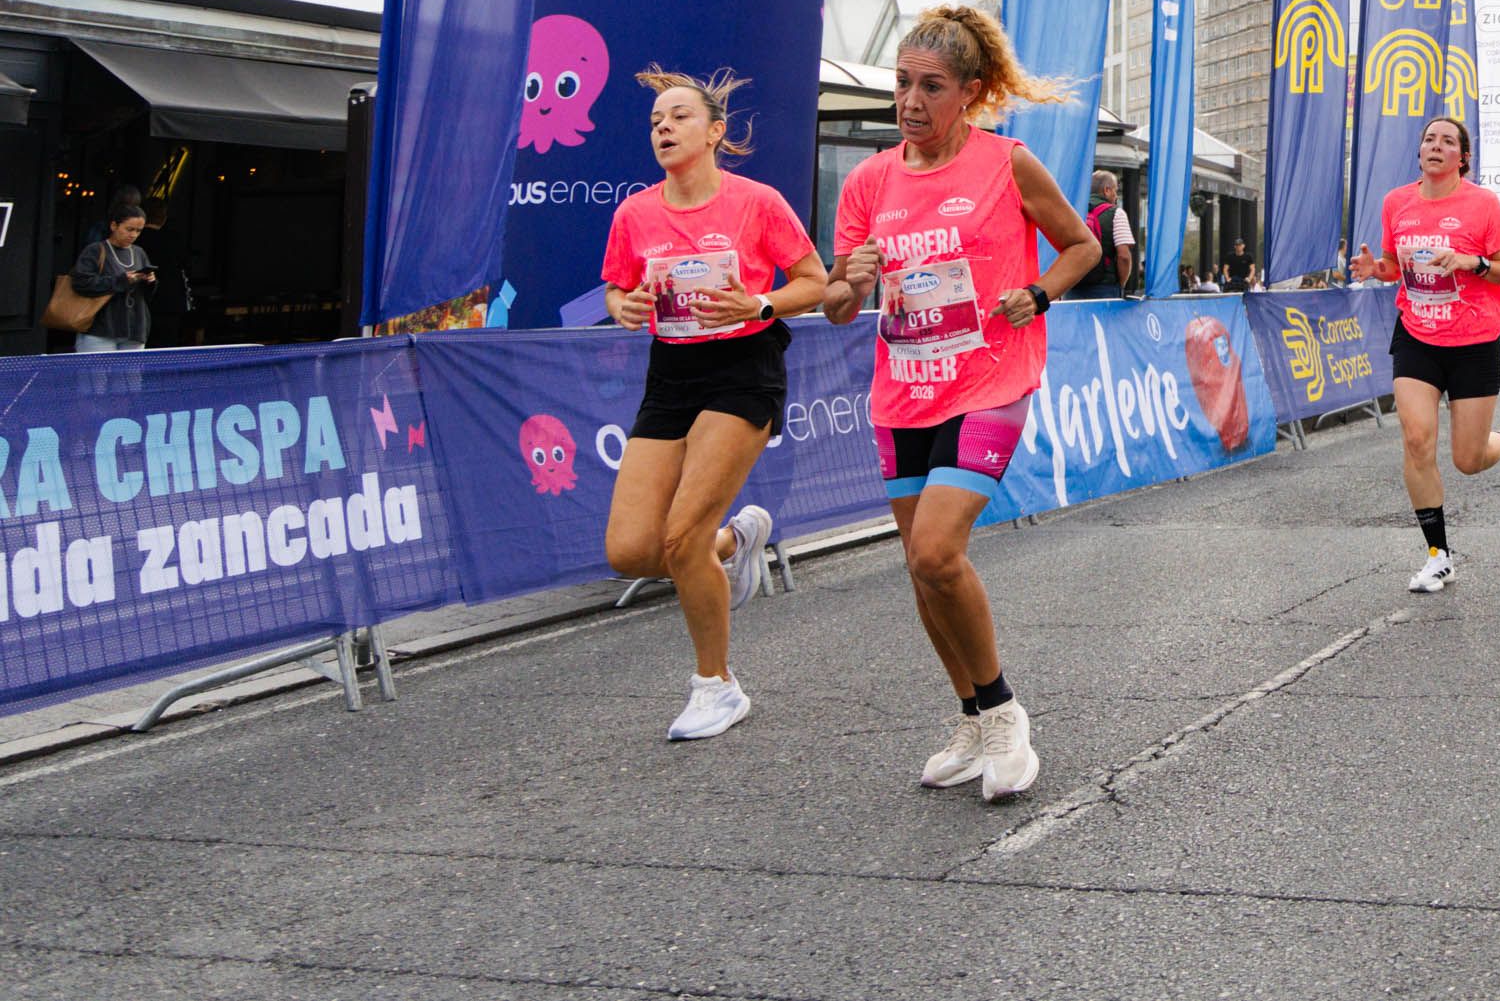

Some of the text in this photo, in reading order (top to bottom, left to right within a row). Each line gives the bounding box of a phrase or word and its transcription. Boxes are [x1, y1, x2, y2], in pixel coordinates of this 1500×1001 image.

[877, 226, 961, 262] CARRERA
[1399, 235, 1450, 249] CARRERA
[1415, 274, 1436, 284] 016
[908, 308, 944, 328] 016
[1318, 316, 1362, 345] Correos
[890, 355, 957, 384] MUJER
[1327, 352, 1372, 389] Express
[95, 396, 346, 502] CHISPA
[137, 472, 422, 594] zancada
